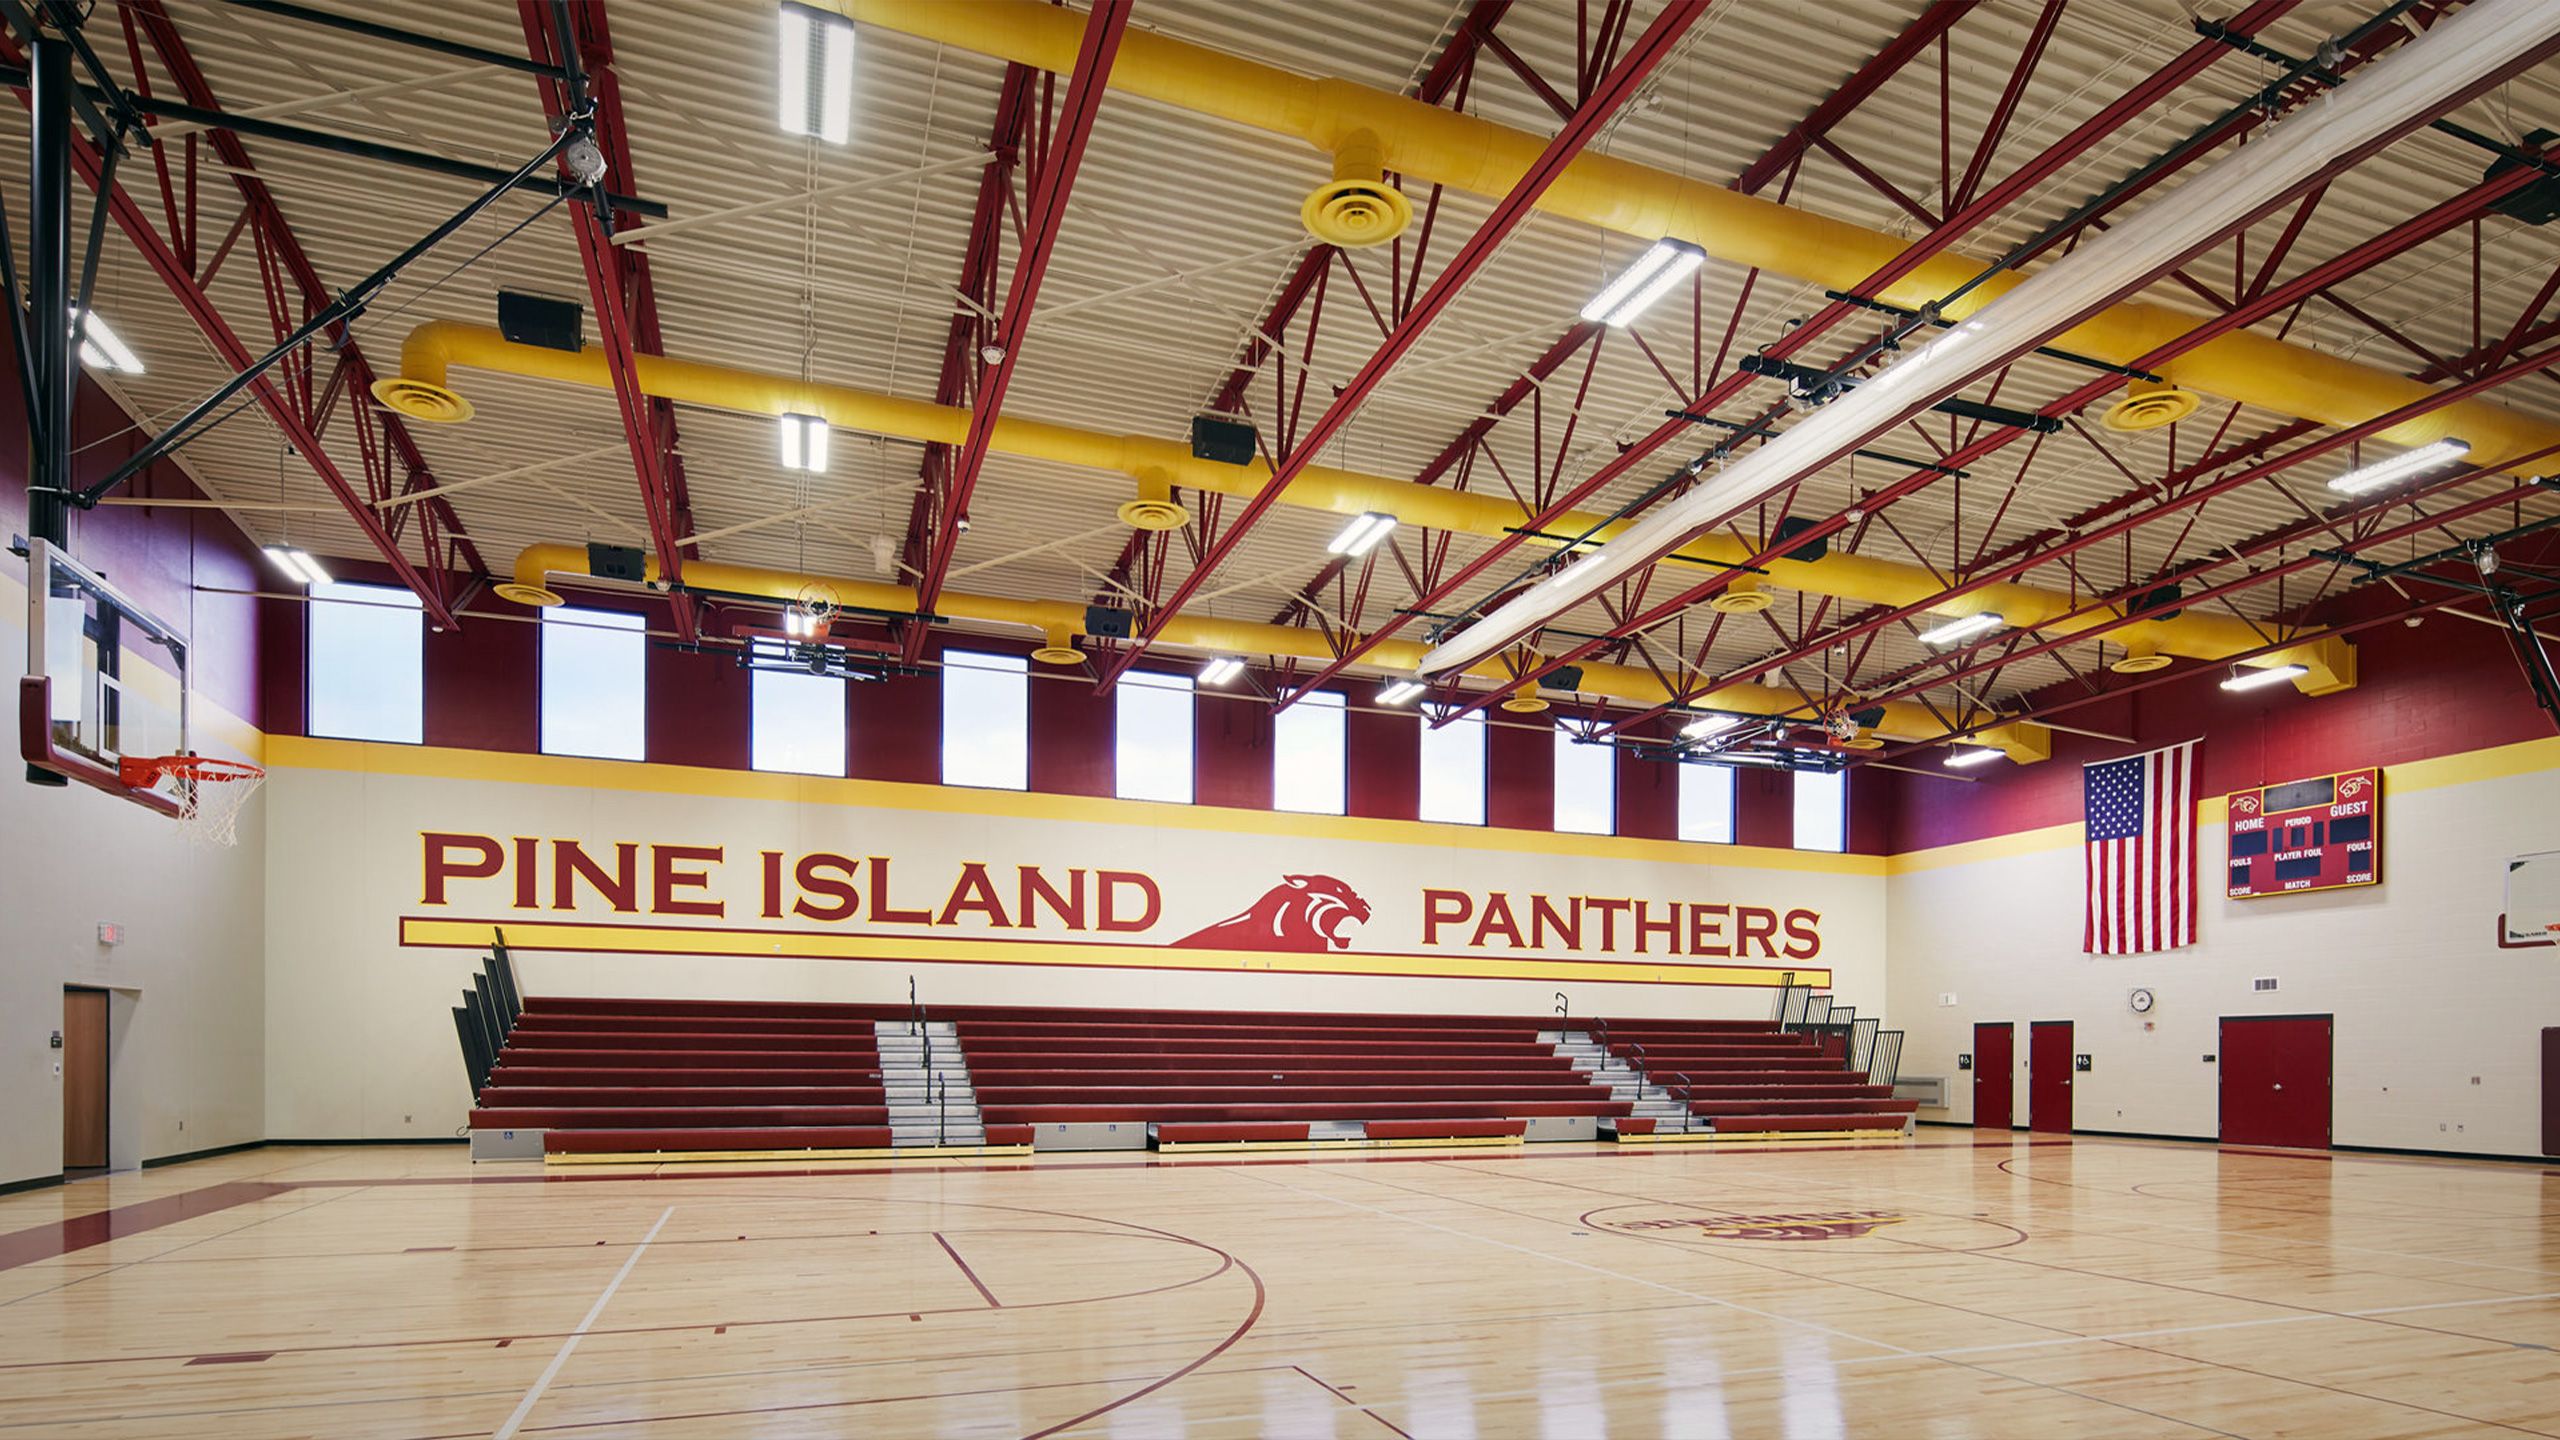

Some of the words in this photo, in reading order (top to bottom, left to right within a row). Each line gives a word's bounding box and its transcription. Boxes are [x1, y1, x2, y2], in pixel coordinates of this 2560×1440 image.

[2330, 801, 2368, 817] GUEST
[2235, 817, 2264, 832] HOME
[2285, 816, 2312, 827] PERIOD
[2347, 841, 2372, 852] FOULS
[2274, 850, 2301, 861] PLAYER
[2303, 848, 2323, 858] FOUL
[2230, 857, 2252, 867] FOULS
[2346, 873, 2372, 883] SCORE
[2285, 880, 2310, 889] MATCH
[419, 832, 726, 919] PINE
[760, 851, 1162, 933] ISLAND
[1421, 888, 1822, 960] PANTHERS
[2229, 886, 2251, 896] SCORE
